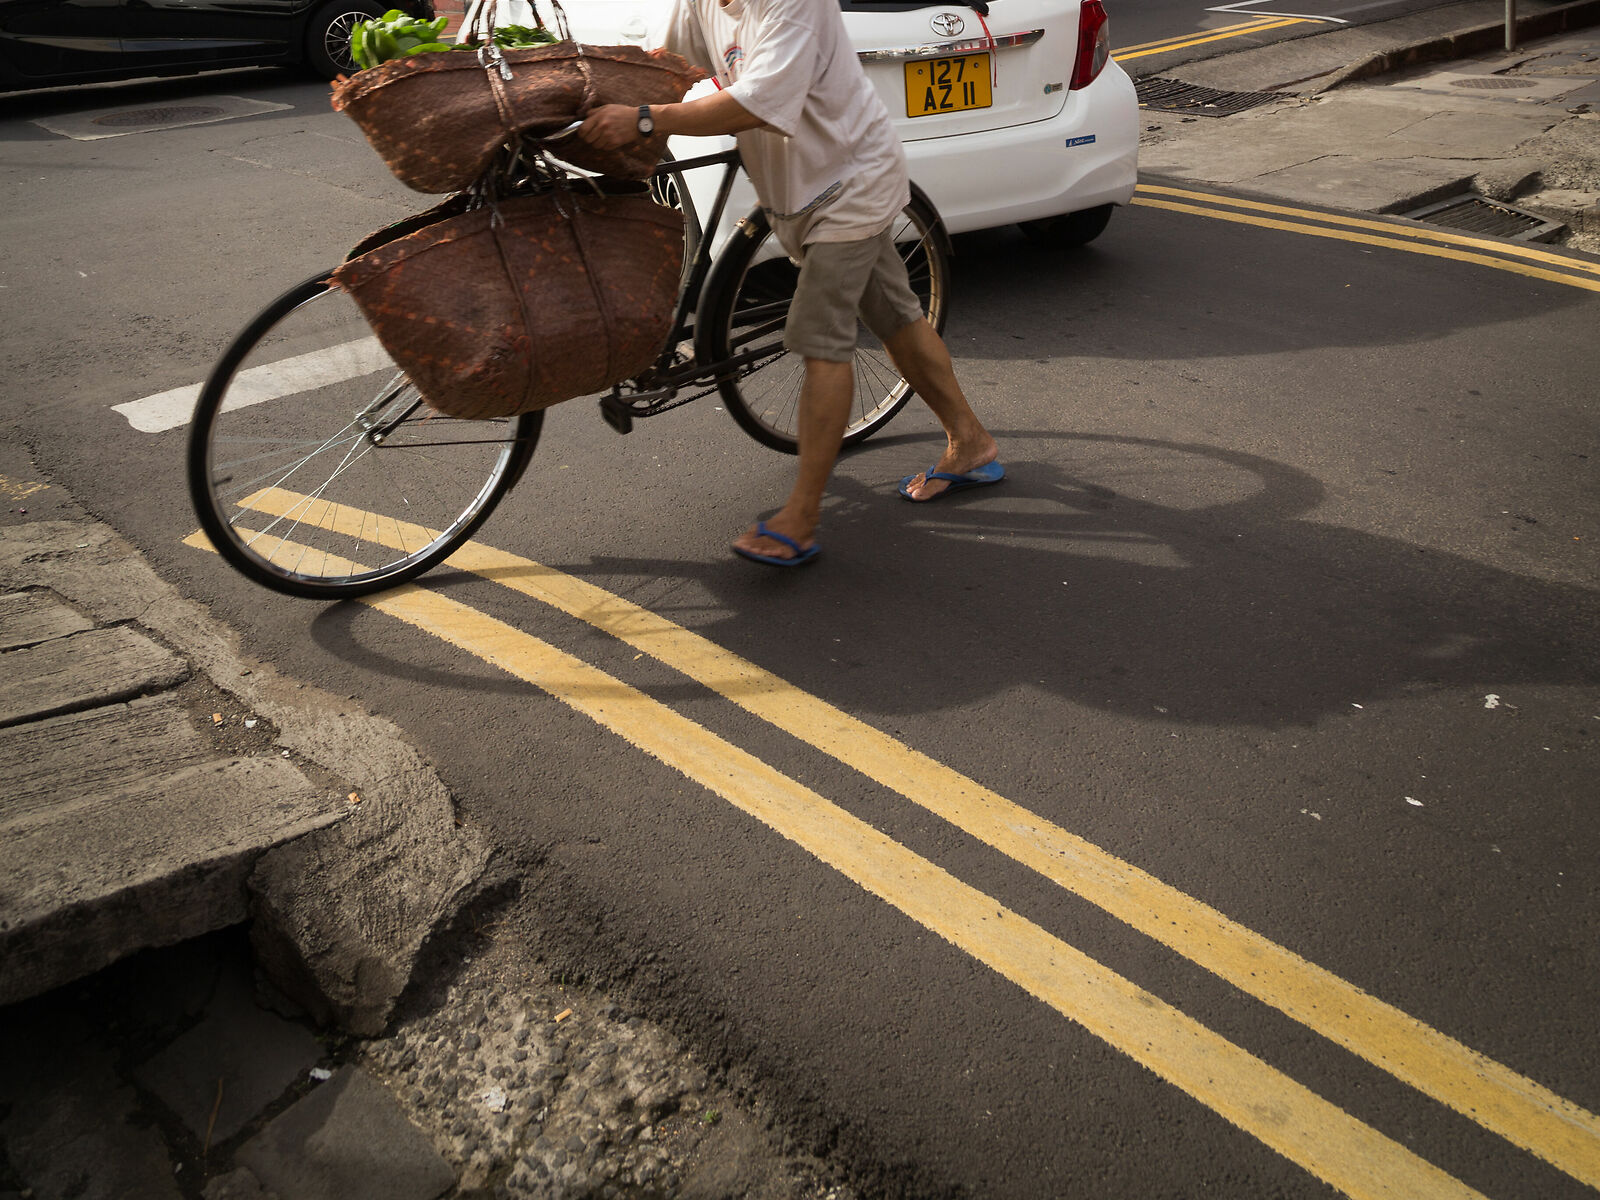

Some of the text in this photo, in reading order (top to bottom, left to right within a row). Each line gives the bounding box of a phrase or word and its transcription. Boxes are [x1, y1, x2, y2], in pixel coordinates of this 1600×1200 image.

[929, 58, 966, 86] 127
[923, 81, 976, 111] AZ 11
